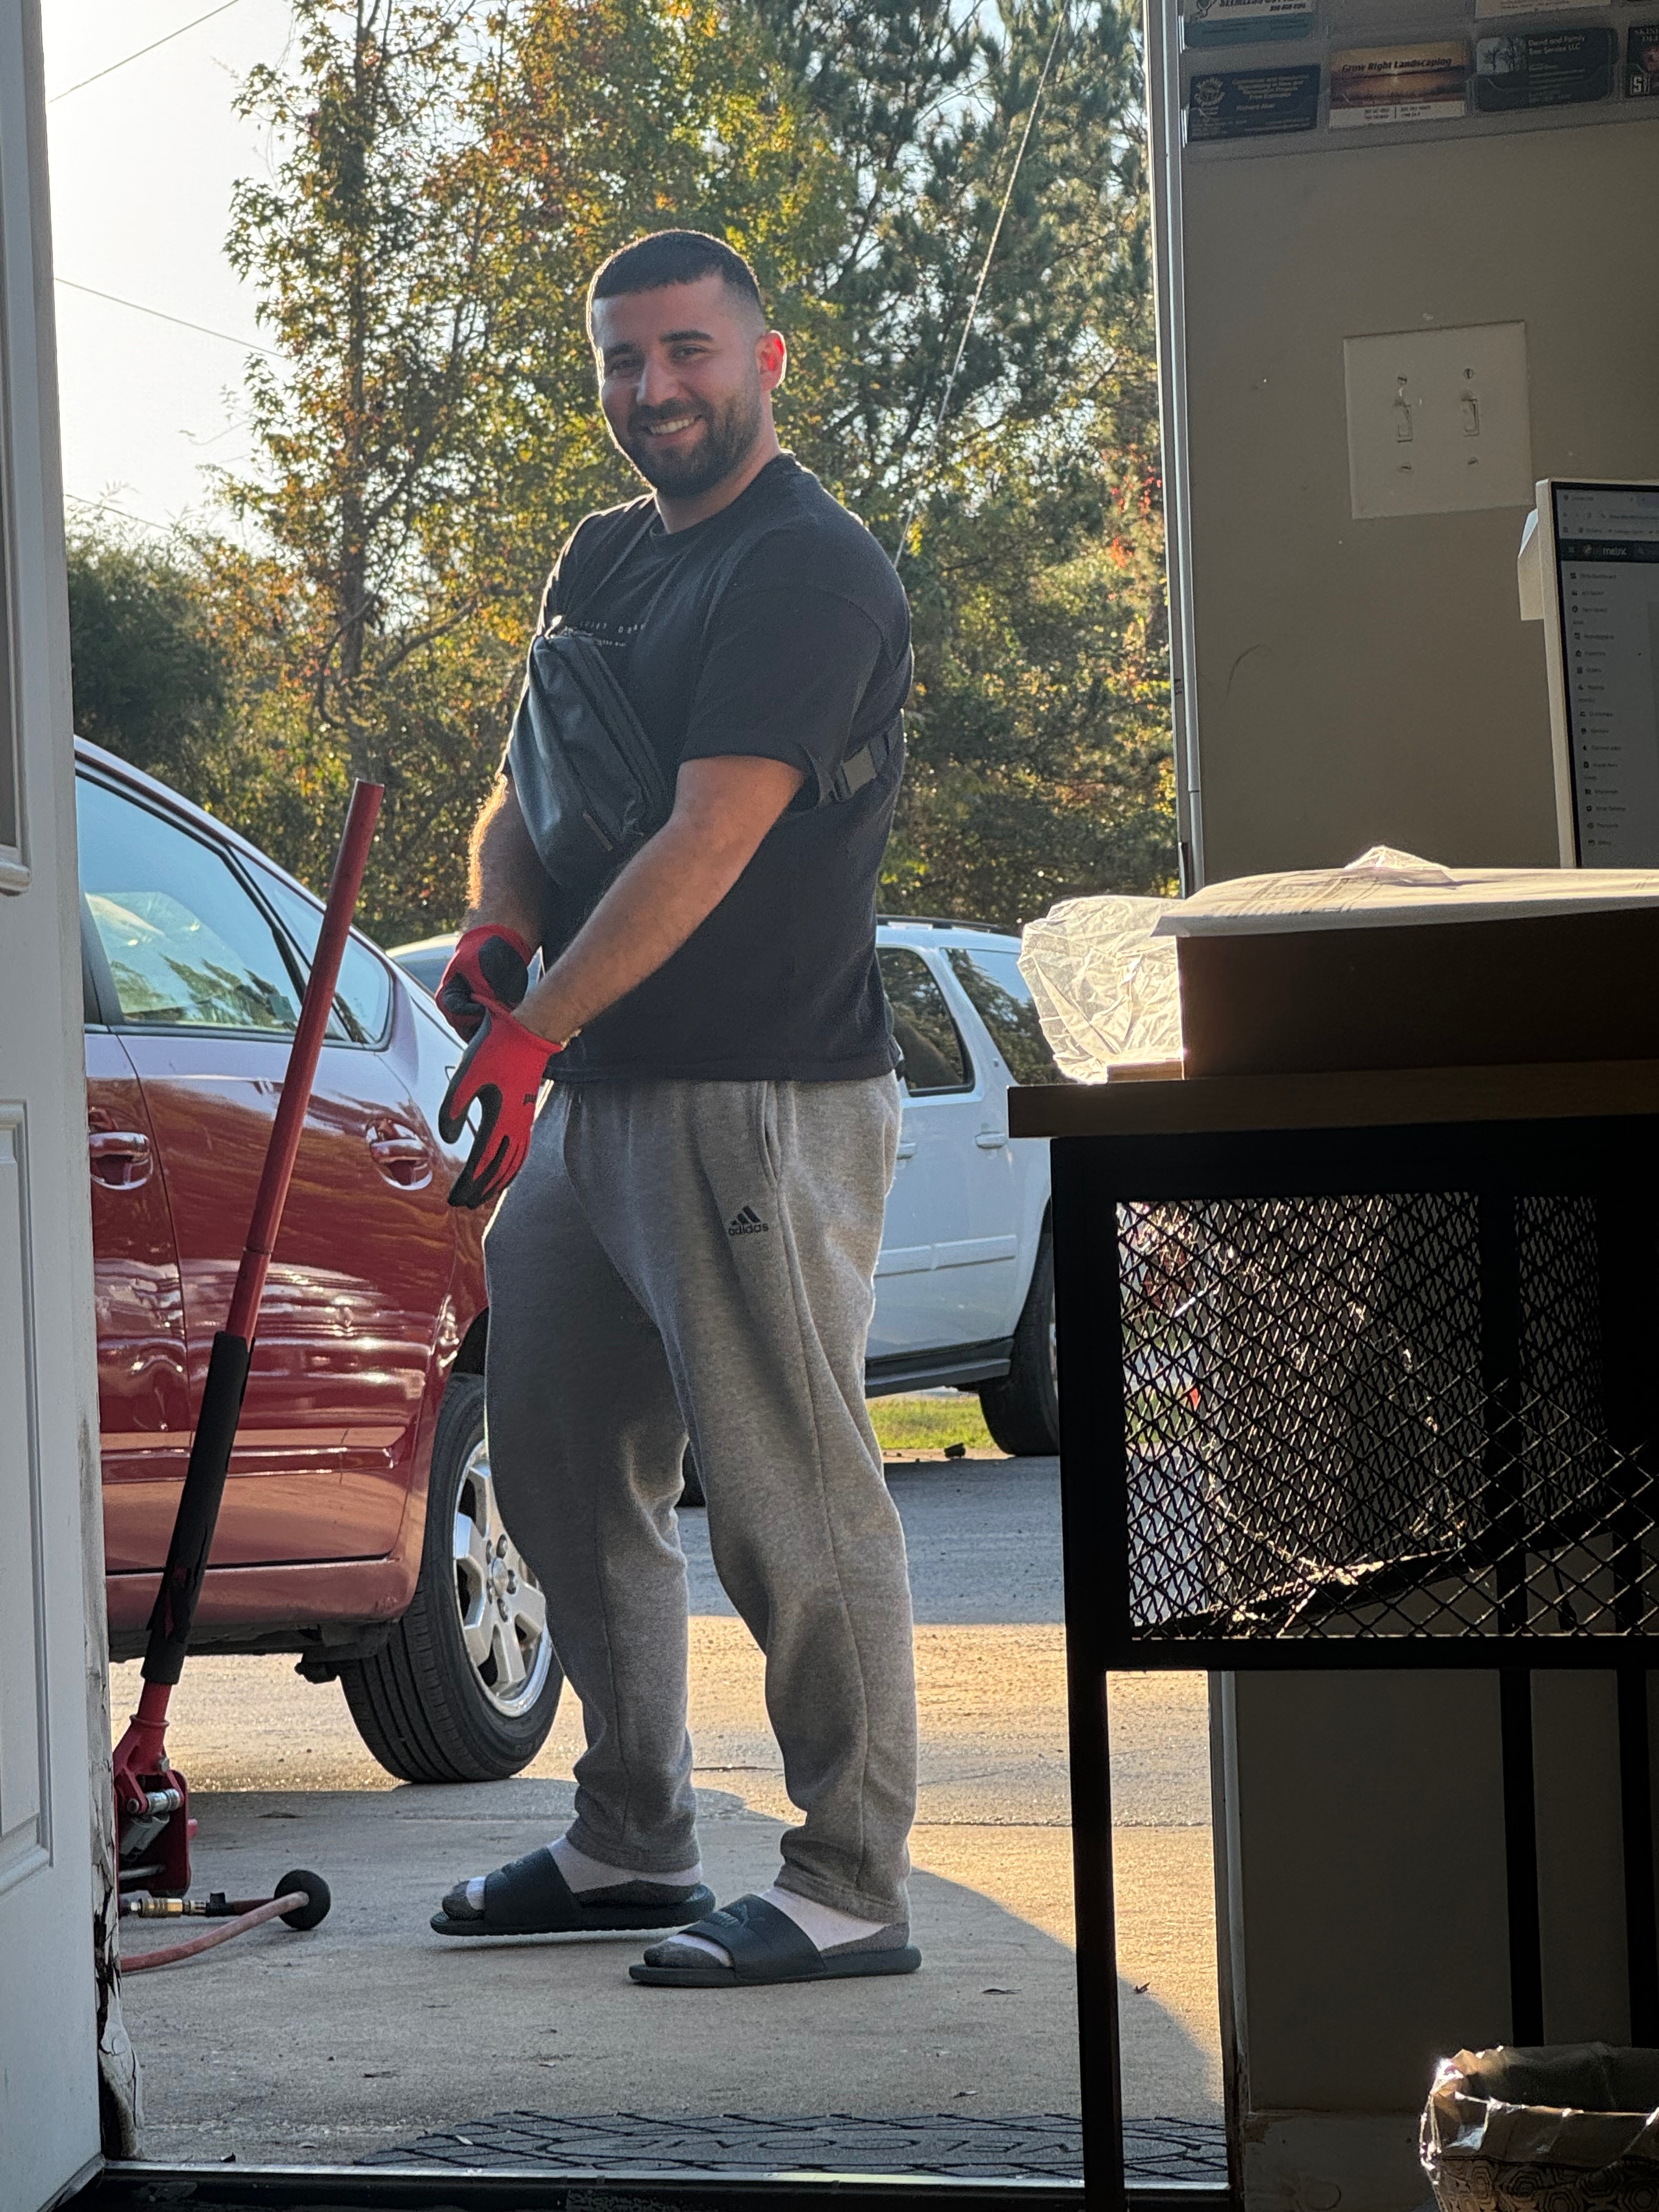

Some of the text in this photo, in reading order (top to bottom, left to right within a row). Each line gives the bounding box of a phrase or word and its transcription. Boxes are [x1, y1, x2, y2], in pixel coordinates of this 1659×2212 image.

[1367, 61, 1391, 71] Right
[1393, 58, 1452, 69] Landscaping
[728, 1223, 769, 1236] adidas
